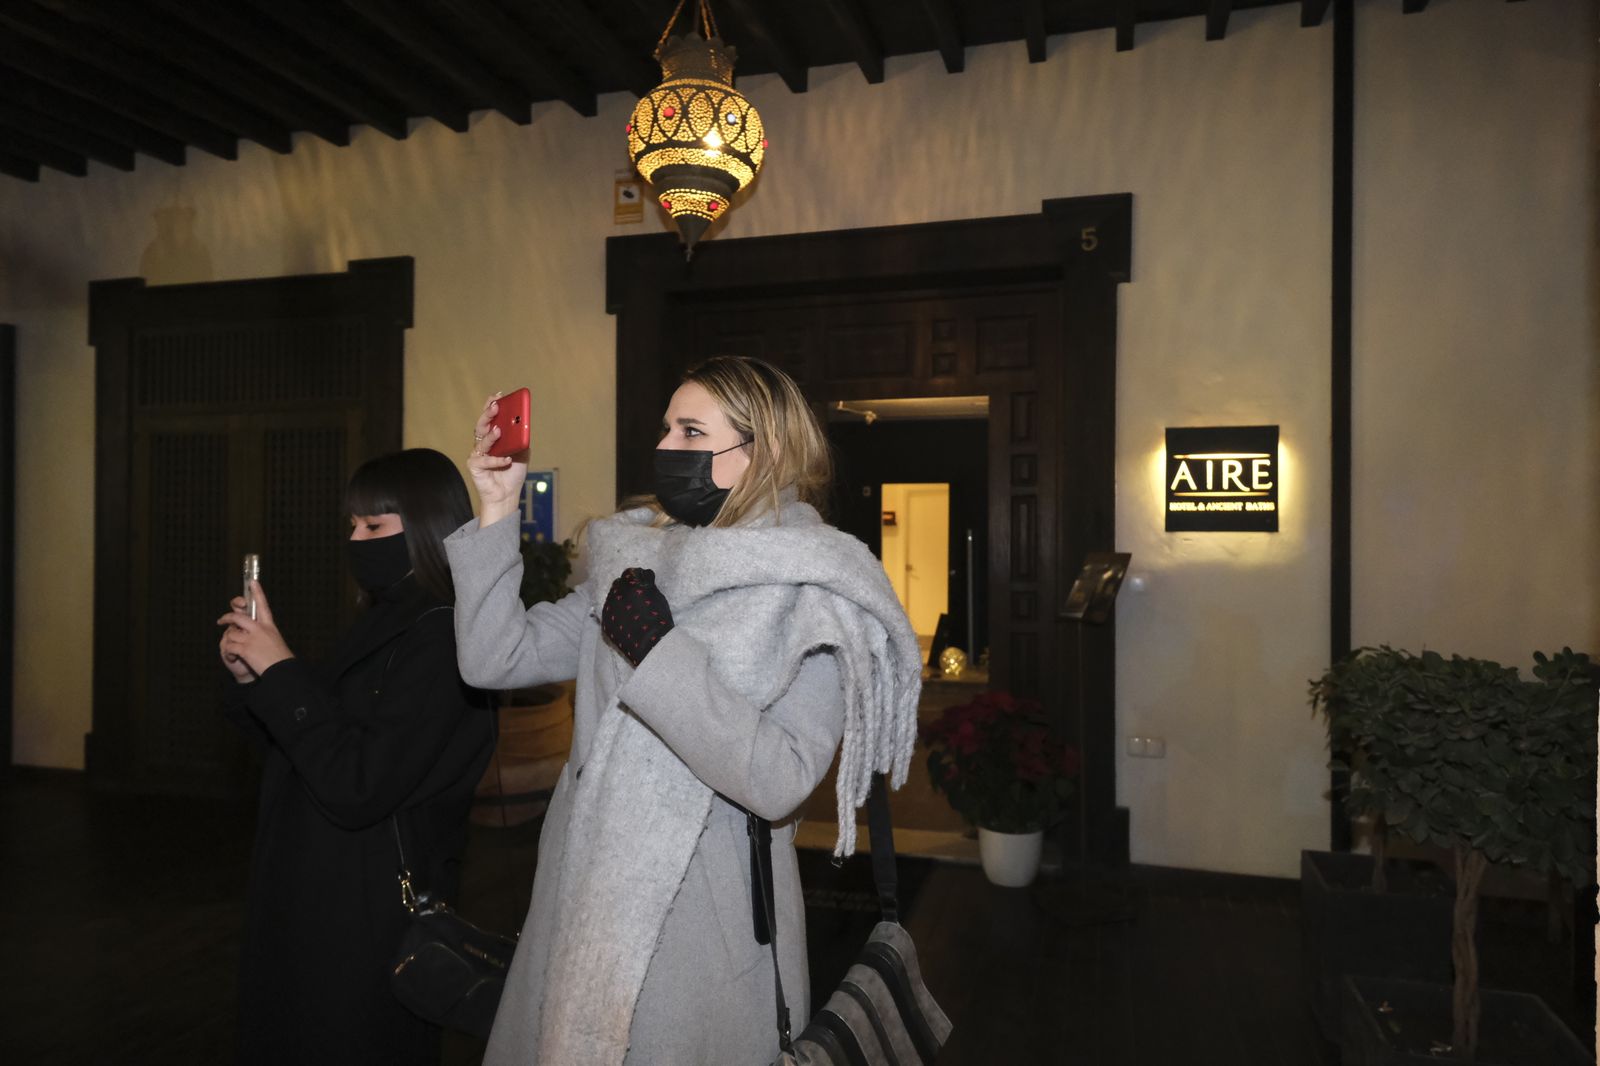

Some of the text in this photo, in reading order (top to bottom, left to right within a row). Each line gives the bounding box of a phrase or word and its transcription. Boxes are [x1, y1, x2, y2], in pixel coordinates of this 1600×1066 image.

[1080, 227, 1098, 252] 5
[1170, 459, 1273, 492] AIRE
[1169, 502, 1275, 511] HOTEL & ANCIENT BATHS
